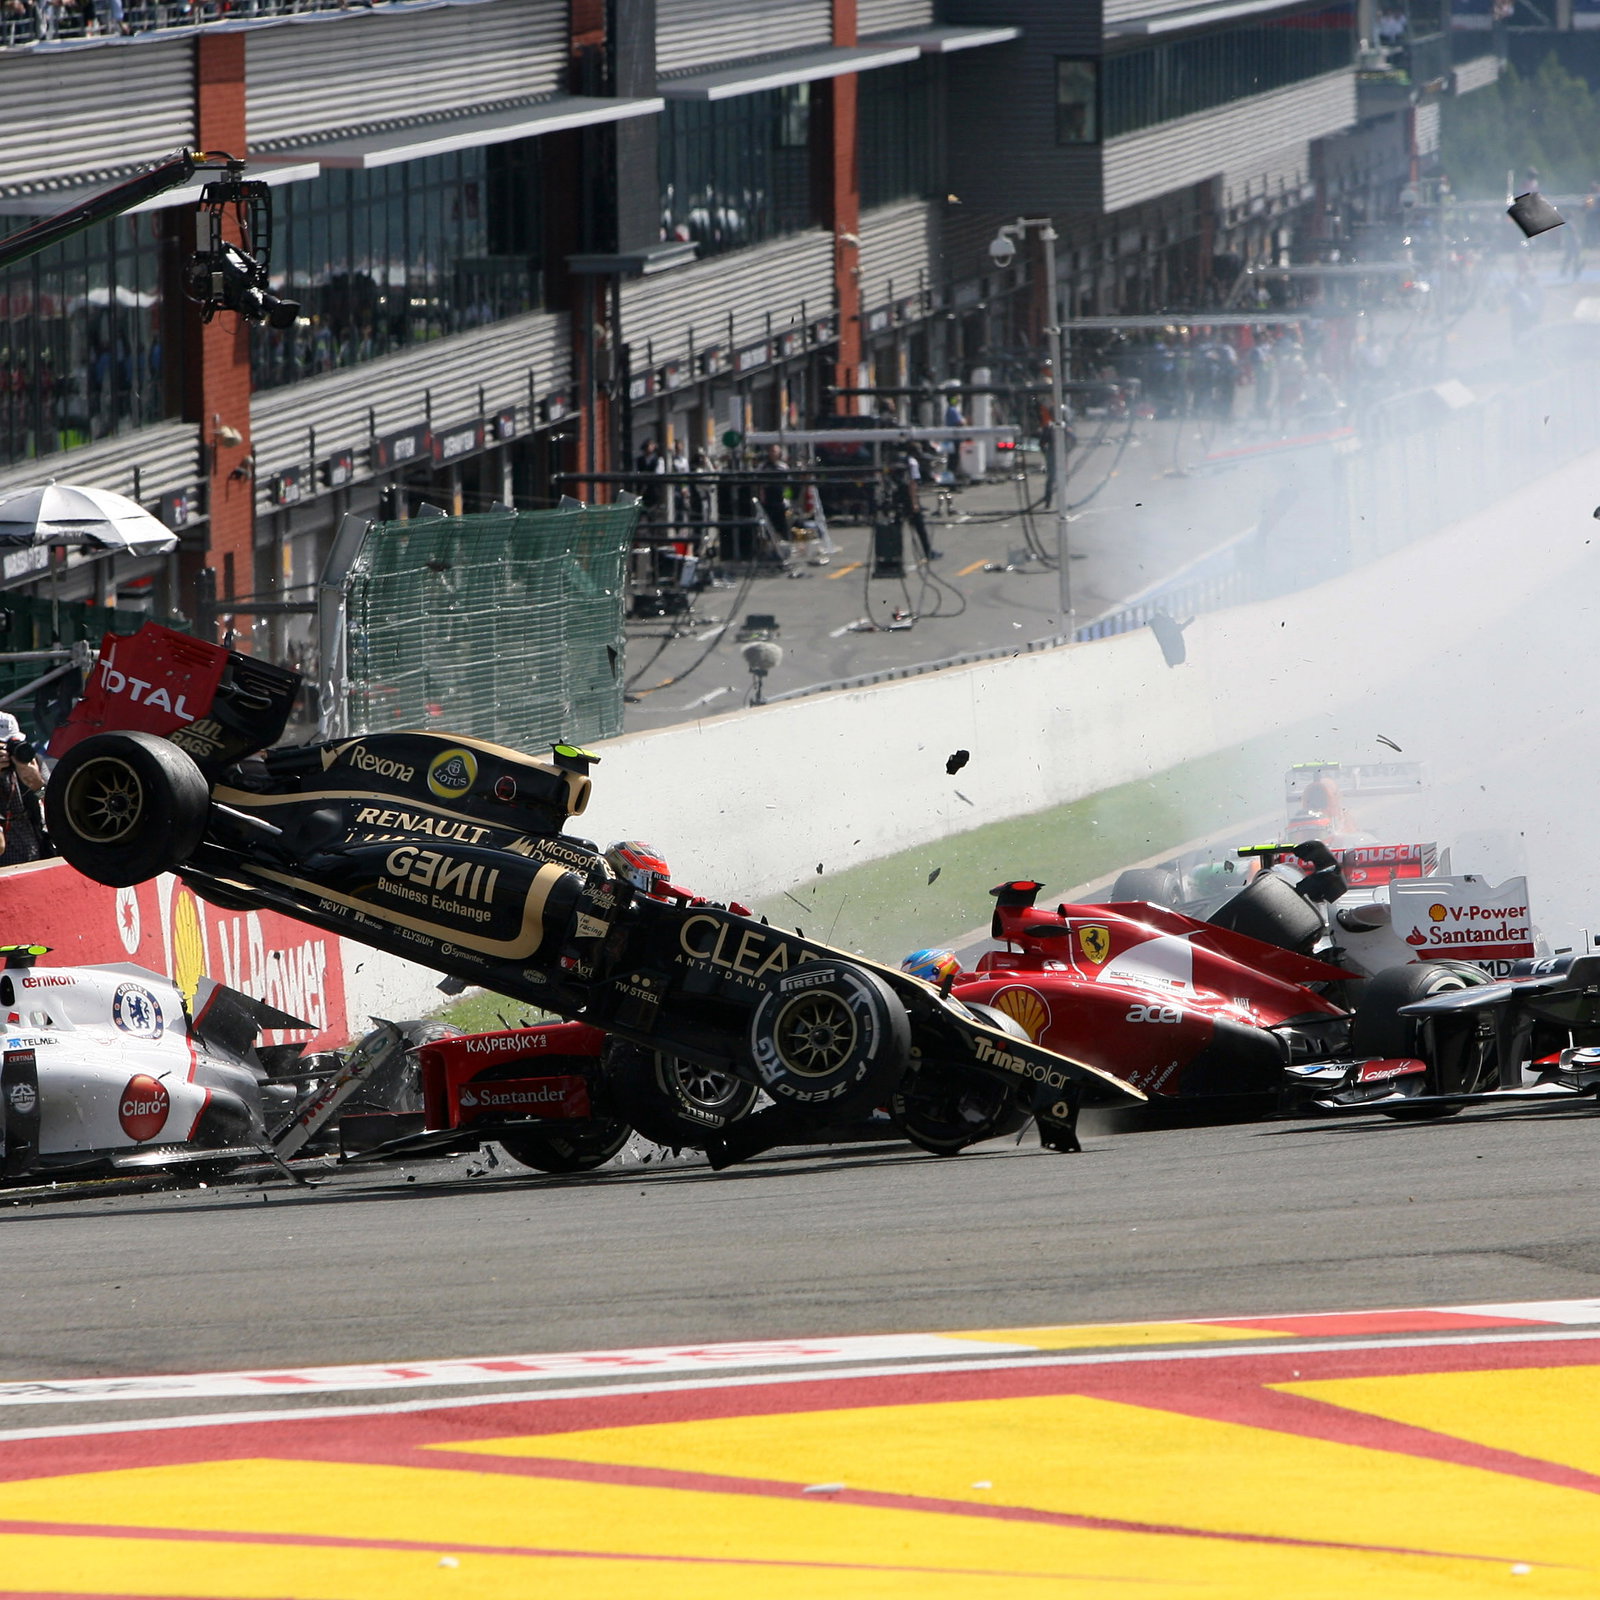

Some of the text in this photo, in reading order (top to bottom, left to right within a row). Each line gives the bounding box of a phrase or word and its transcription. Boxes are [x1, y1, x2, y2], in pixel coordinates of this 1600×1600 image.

[100, 659, 194, 722] TOTAL
[350, 746, 415, 783] Rexona
[434, 769, 467, 787] LOTUS
[356, 807, 491, 844] RENAULT
[536, 838, 600, 871] Microsoft
[377, 876, 492, 923] Business Exchange
[1450, 905, 1526, 921] V-Power
[401, 929, 434, 947] ELYSIUM
[1429, 922, 1528, 944] Santander
[1529, 958, 1559, 975] 14
[117, 983, 148, 997] CHELSEA
[780, 968, 835, 992] PIRELLI
[614, 981, 660, 1005] TW STEEL
[1125, 1004, 1183, 1024] acer
[22, 1038, 60, 1047] TELMEX
[466, 1033, 540, 1055] KASPERSKY
[480, 1085, 566, 1107] Santander
[775, 1081, 848, 1103] ZERO
[122, 1100, 161, 1117] Claro
